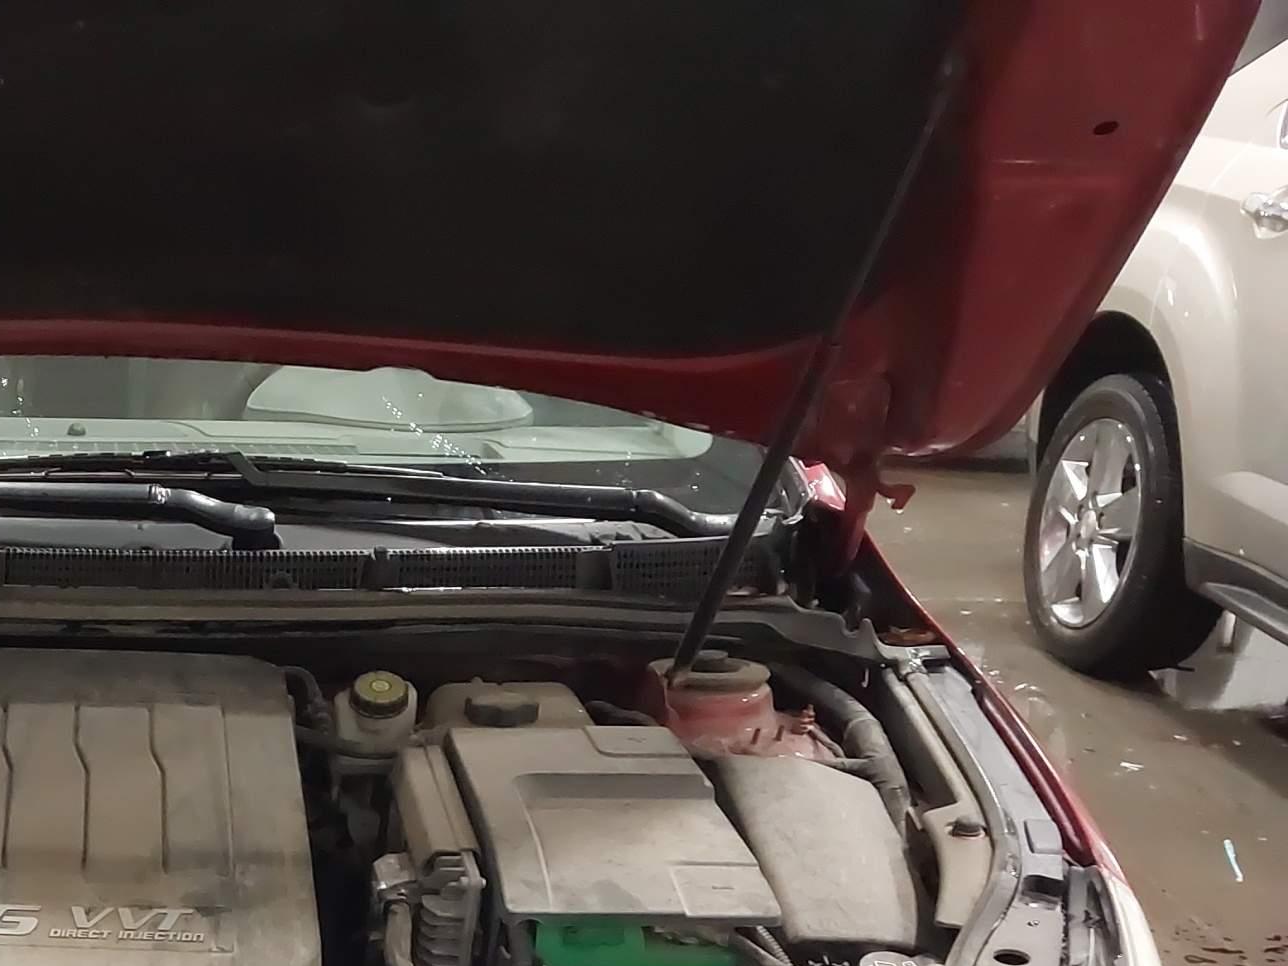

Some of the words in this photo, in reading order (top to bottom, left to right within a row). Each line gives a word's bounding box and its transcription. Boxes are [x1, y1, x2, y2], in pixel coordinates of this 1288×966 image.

[71, 905, 194, 931] VVT
[48, 928, 112, 940] DIRECT
[118, 930, 205, 942] INJECTION
